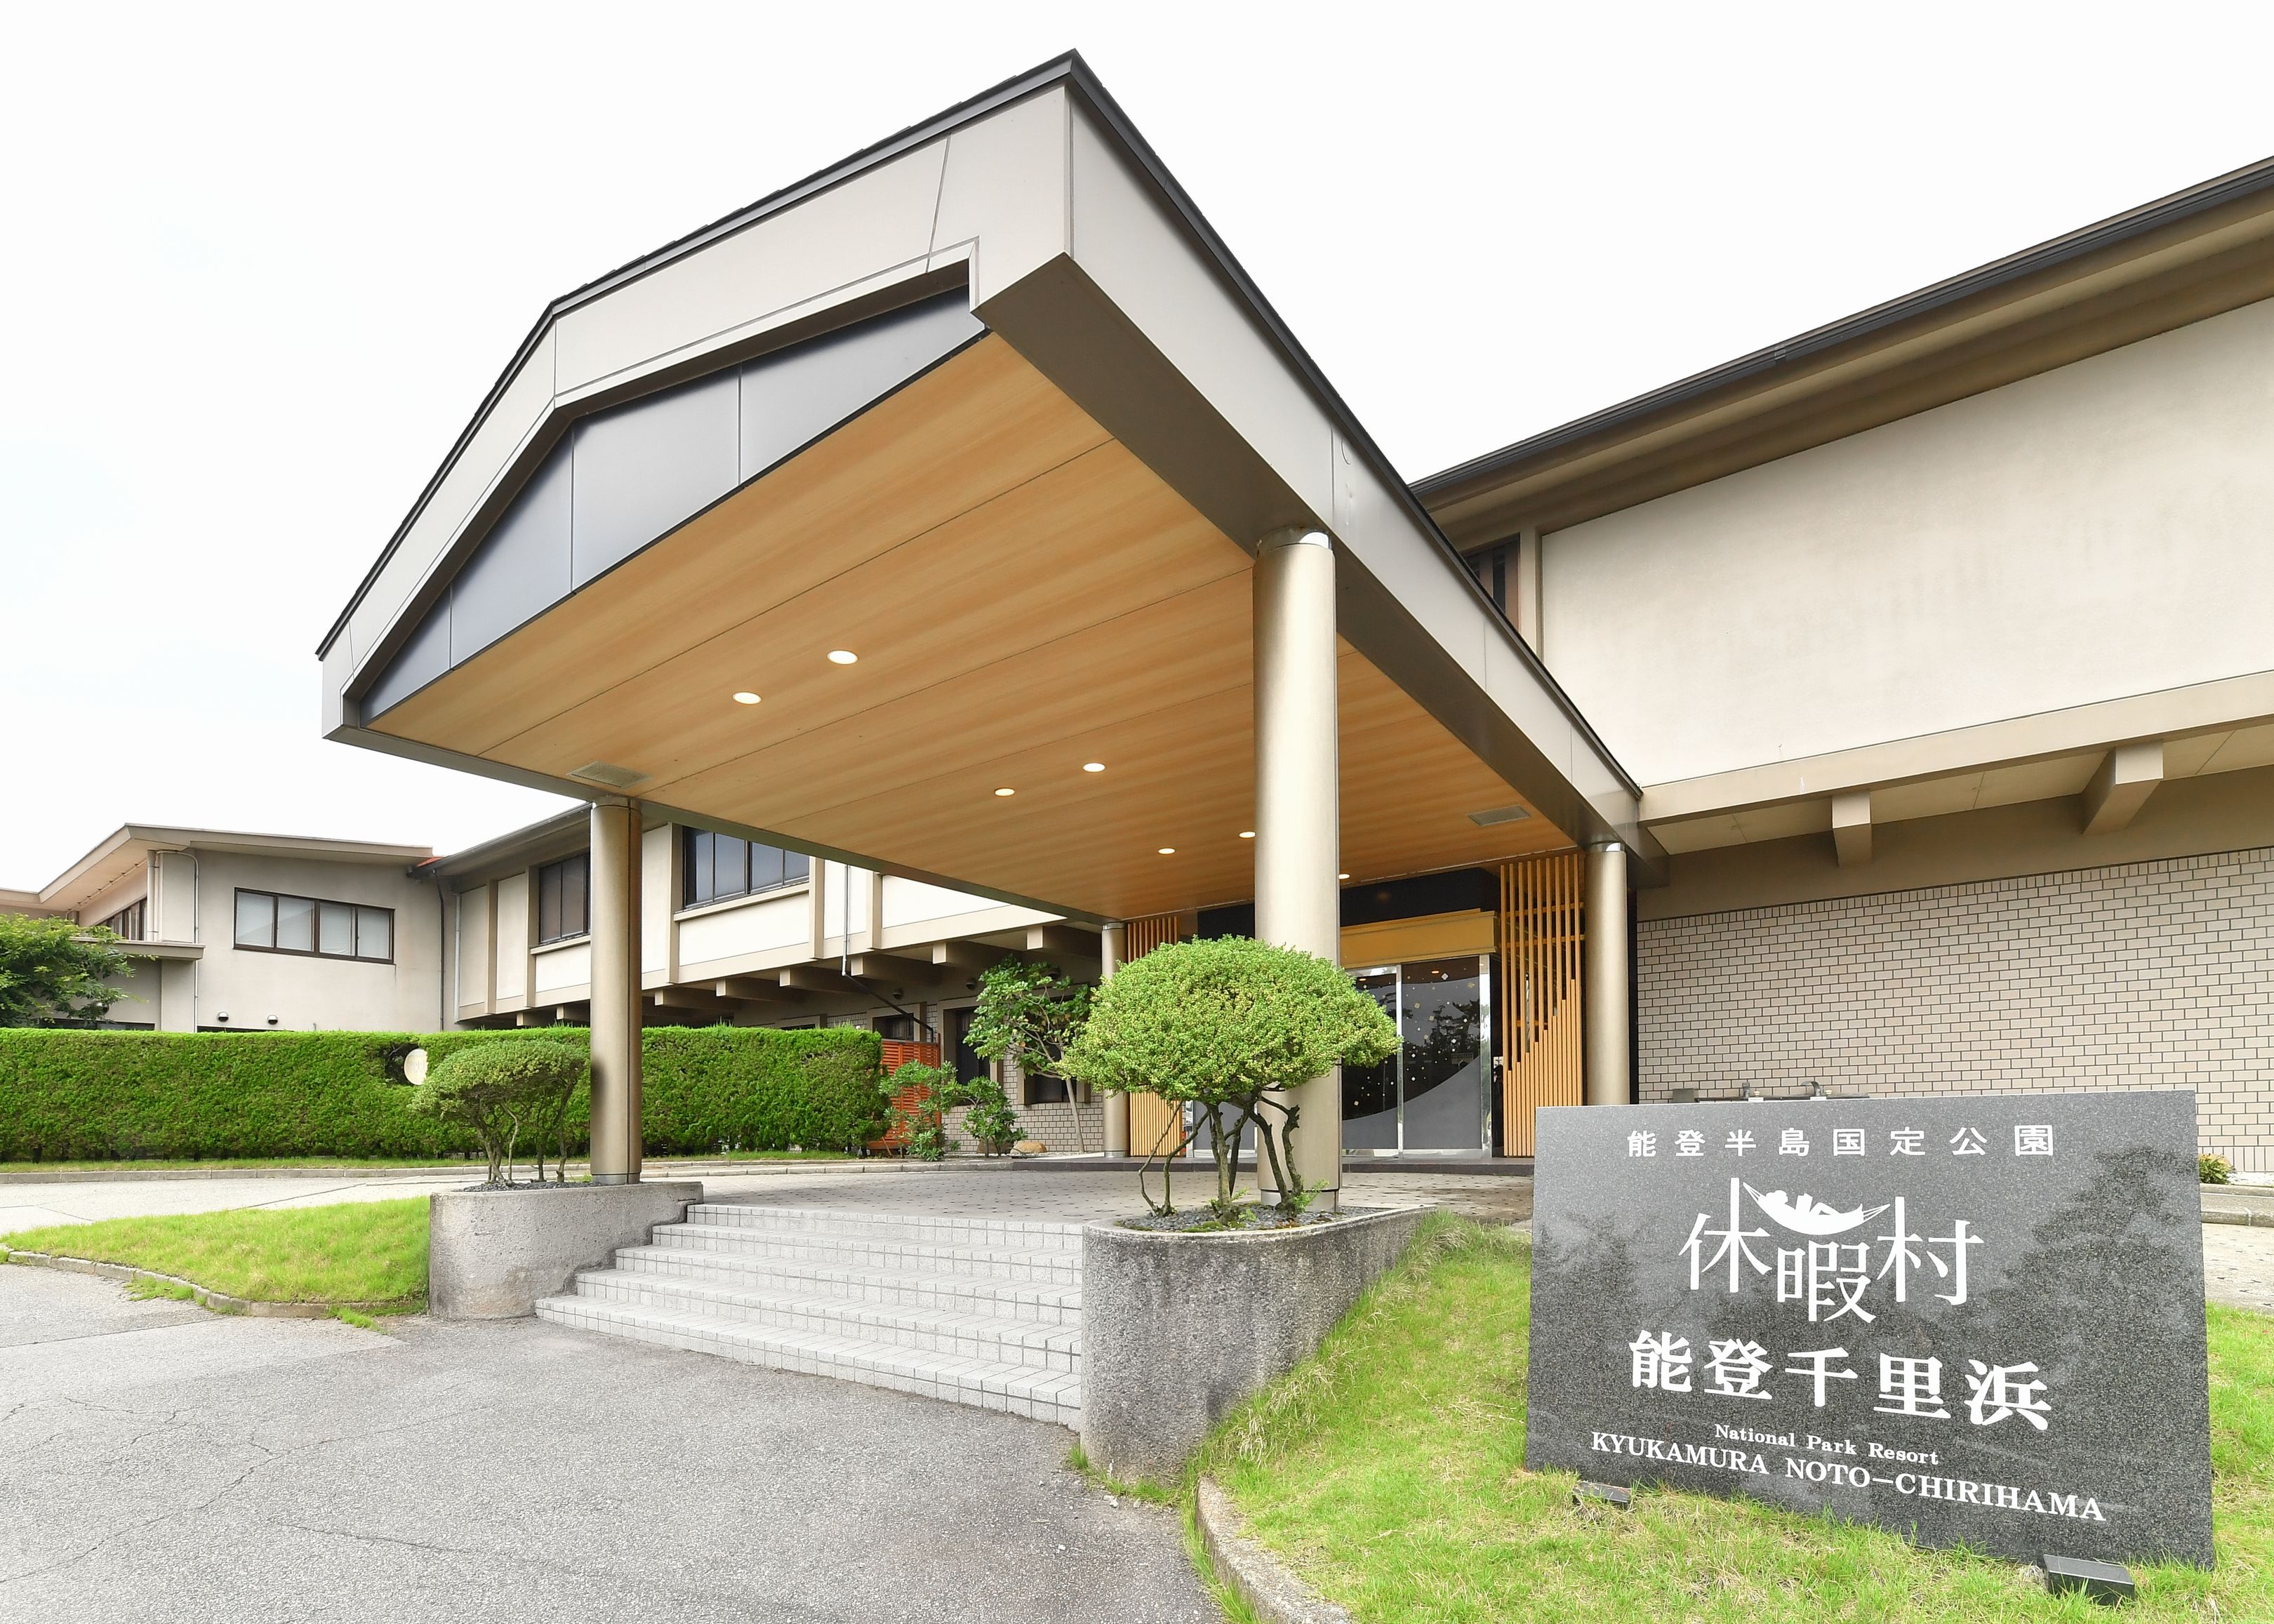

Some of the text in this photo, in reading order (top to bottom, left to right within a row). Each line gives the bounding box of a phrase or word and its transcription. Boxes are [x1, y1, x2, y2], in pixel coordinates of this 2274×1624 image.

[1626, 1122, 2054, 1158] 能登半島国定公園
[1677, 1176, 1986, 1324] 休暇村
[1628, 1329, 2053, 1432] 能登千里浜
[1590, 1430, 1769, 1475] KYUKAMURA
[1714, 1423, 1939, 1466] National Park Resort
